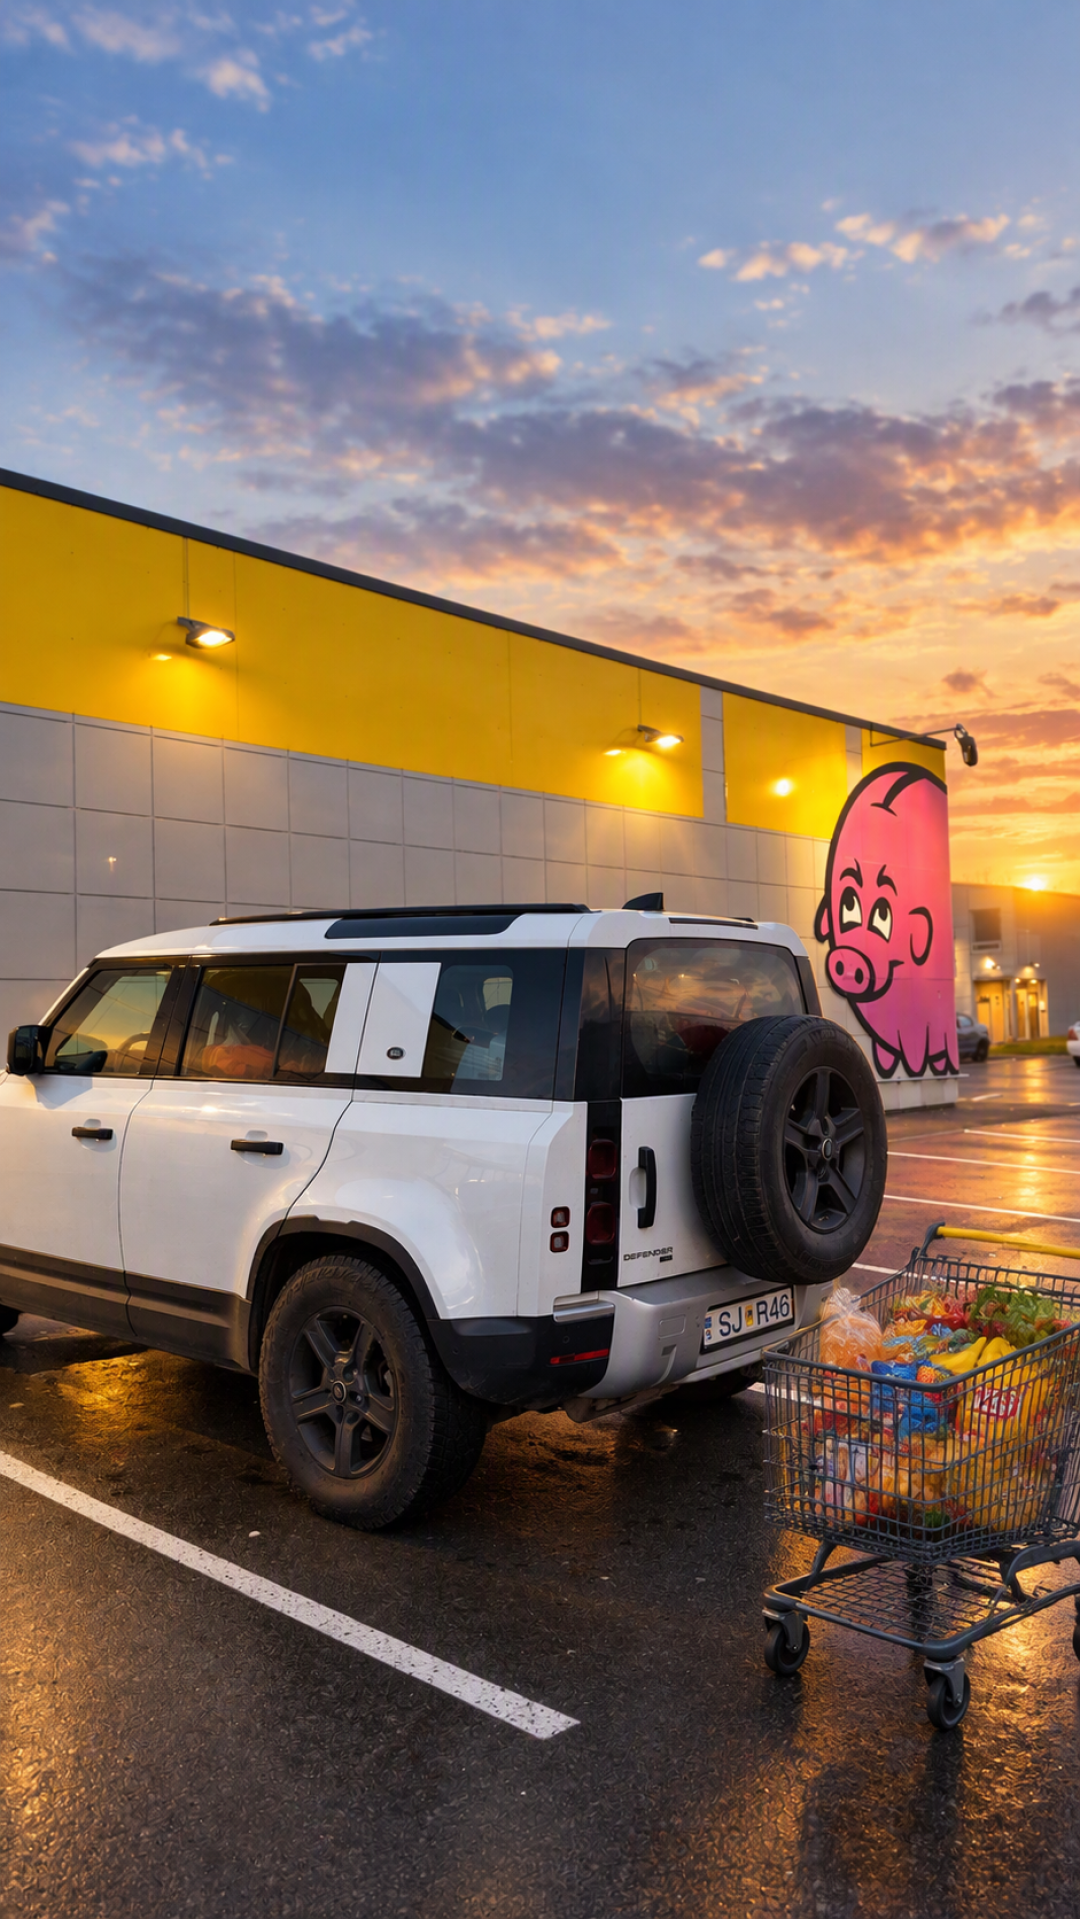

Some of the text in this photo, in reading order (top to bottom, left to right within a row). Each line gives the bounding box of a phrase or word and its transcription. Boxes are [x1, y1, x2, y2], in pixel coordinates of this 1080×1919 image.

[623, 1246, 673, 1261] DEFENDER
[719, 1294, 790, 1337] SJ R46
